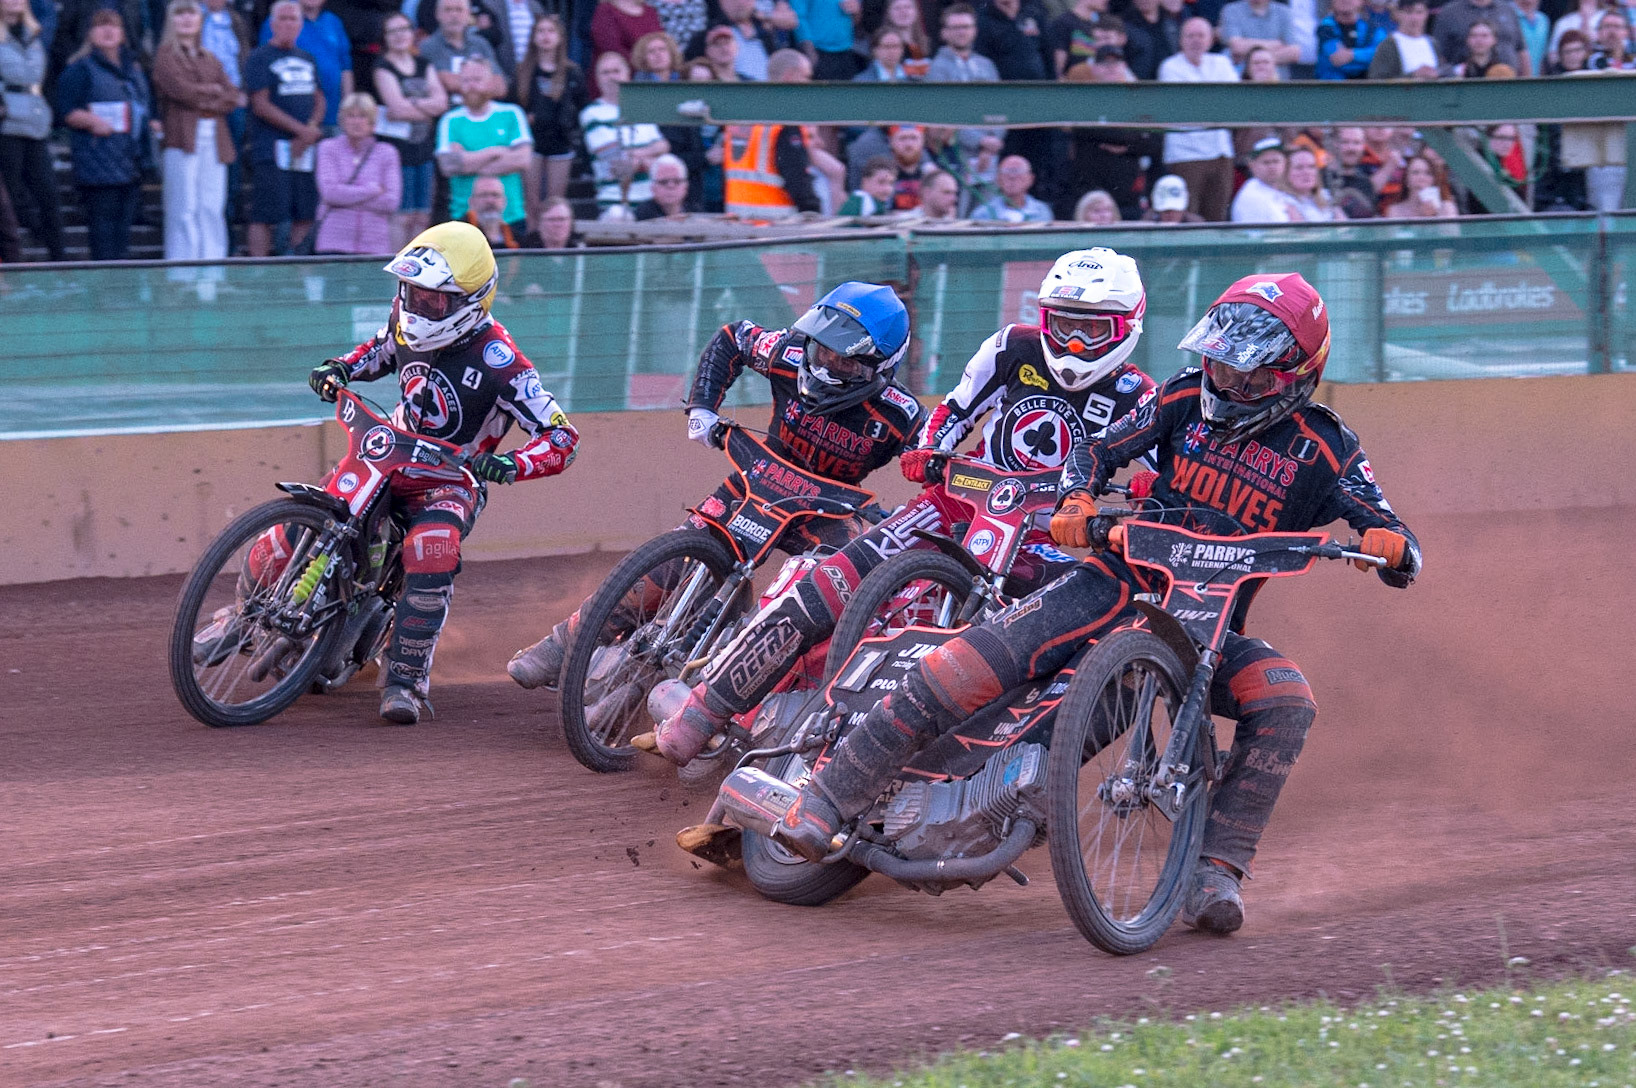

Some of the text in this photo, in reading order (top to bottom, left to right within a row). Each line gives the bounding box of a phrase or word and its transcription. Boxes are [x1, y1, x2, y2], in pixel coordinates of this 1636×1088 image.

[490, 345, 508, 361] ATPI
[402, 366, 422, 383] BELLE
[442, 386, 457, 412] ACES
[466, 370, 478, 388] 4
[883, 387, 909, 404] Joker
[1087, 399, 1111, 419] 5
[800, 414, 874, 455] PARRYS
[871, 421, 882, 439] 3
[1013, 400, 1082, 444] BELLE VUE ACE
[760, 478, 811, 509] INTERNATNAL
[763, 462, 822, 502] PARRYS
[1170, 455, 1284, 533] WOLVES
[731, 514, 772, 541] BORGE
[425, 541, 458, 558] agilia
[1193, 543, 1257, 565] PARRYS
[842, 650, 881, 687] 1
